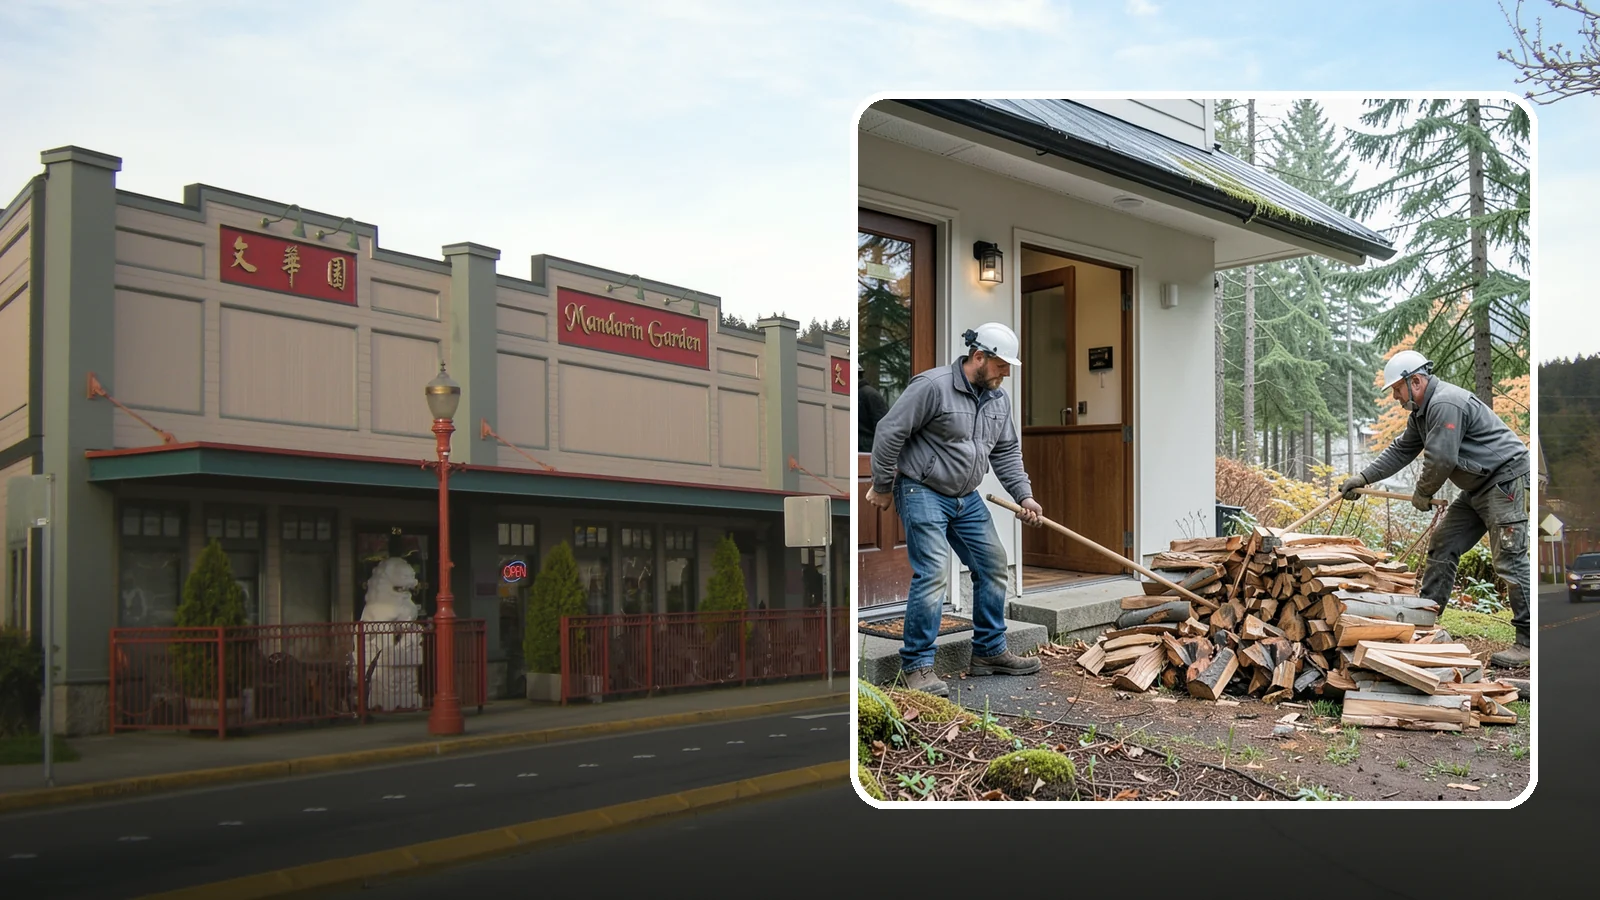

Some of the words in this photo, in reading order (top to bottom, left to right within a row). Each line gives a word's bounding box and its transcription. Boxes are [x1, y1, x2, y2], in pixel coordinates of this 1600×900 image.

[230, 236, 346, 291] 文華園
[564, 302, 644, 341] Mandarin
[648, 320, 701, 352] Garden
[503, 565, 527, 578] OPEN
